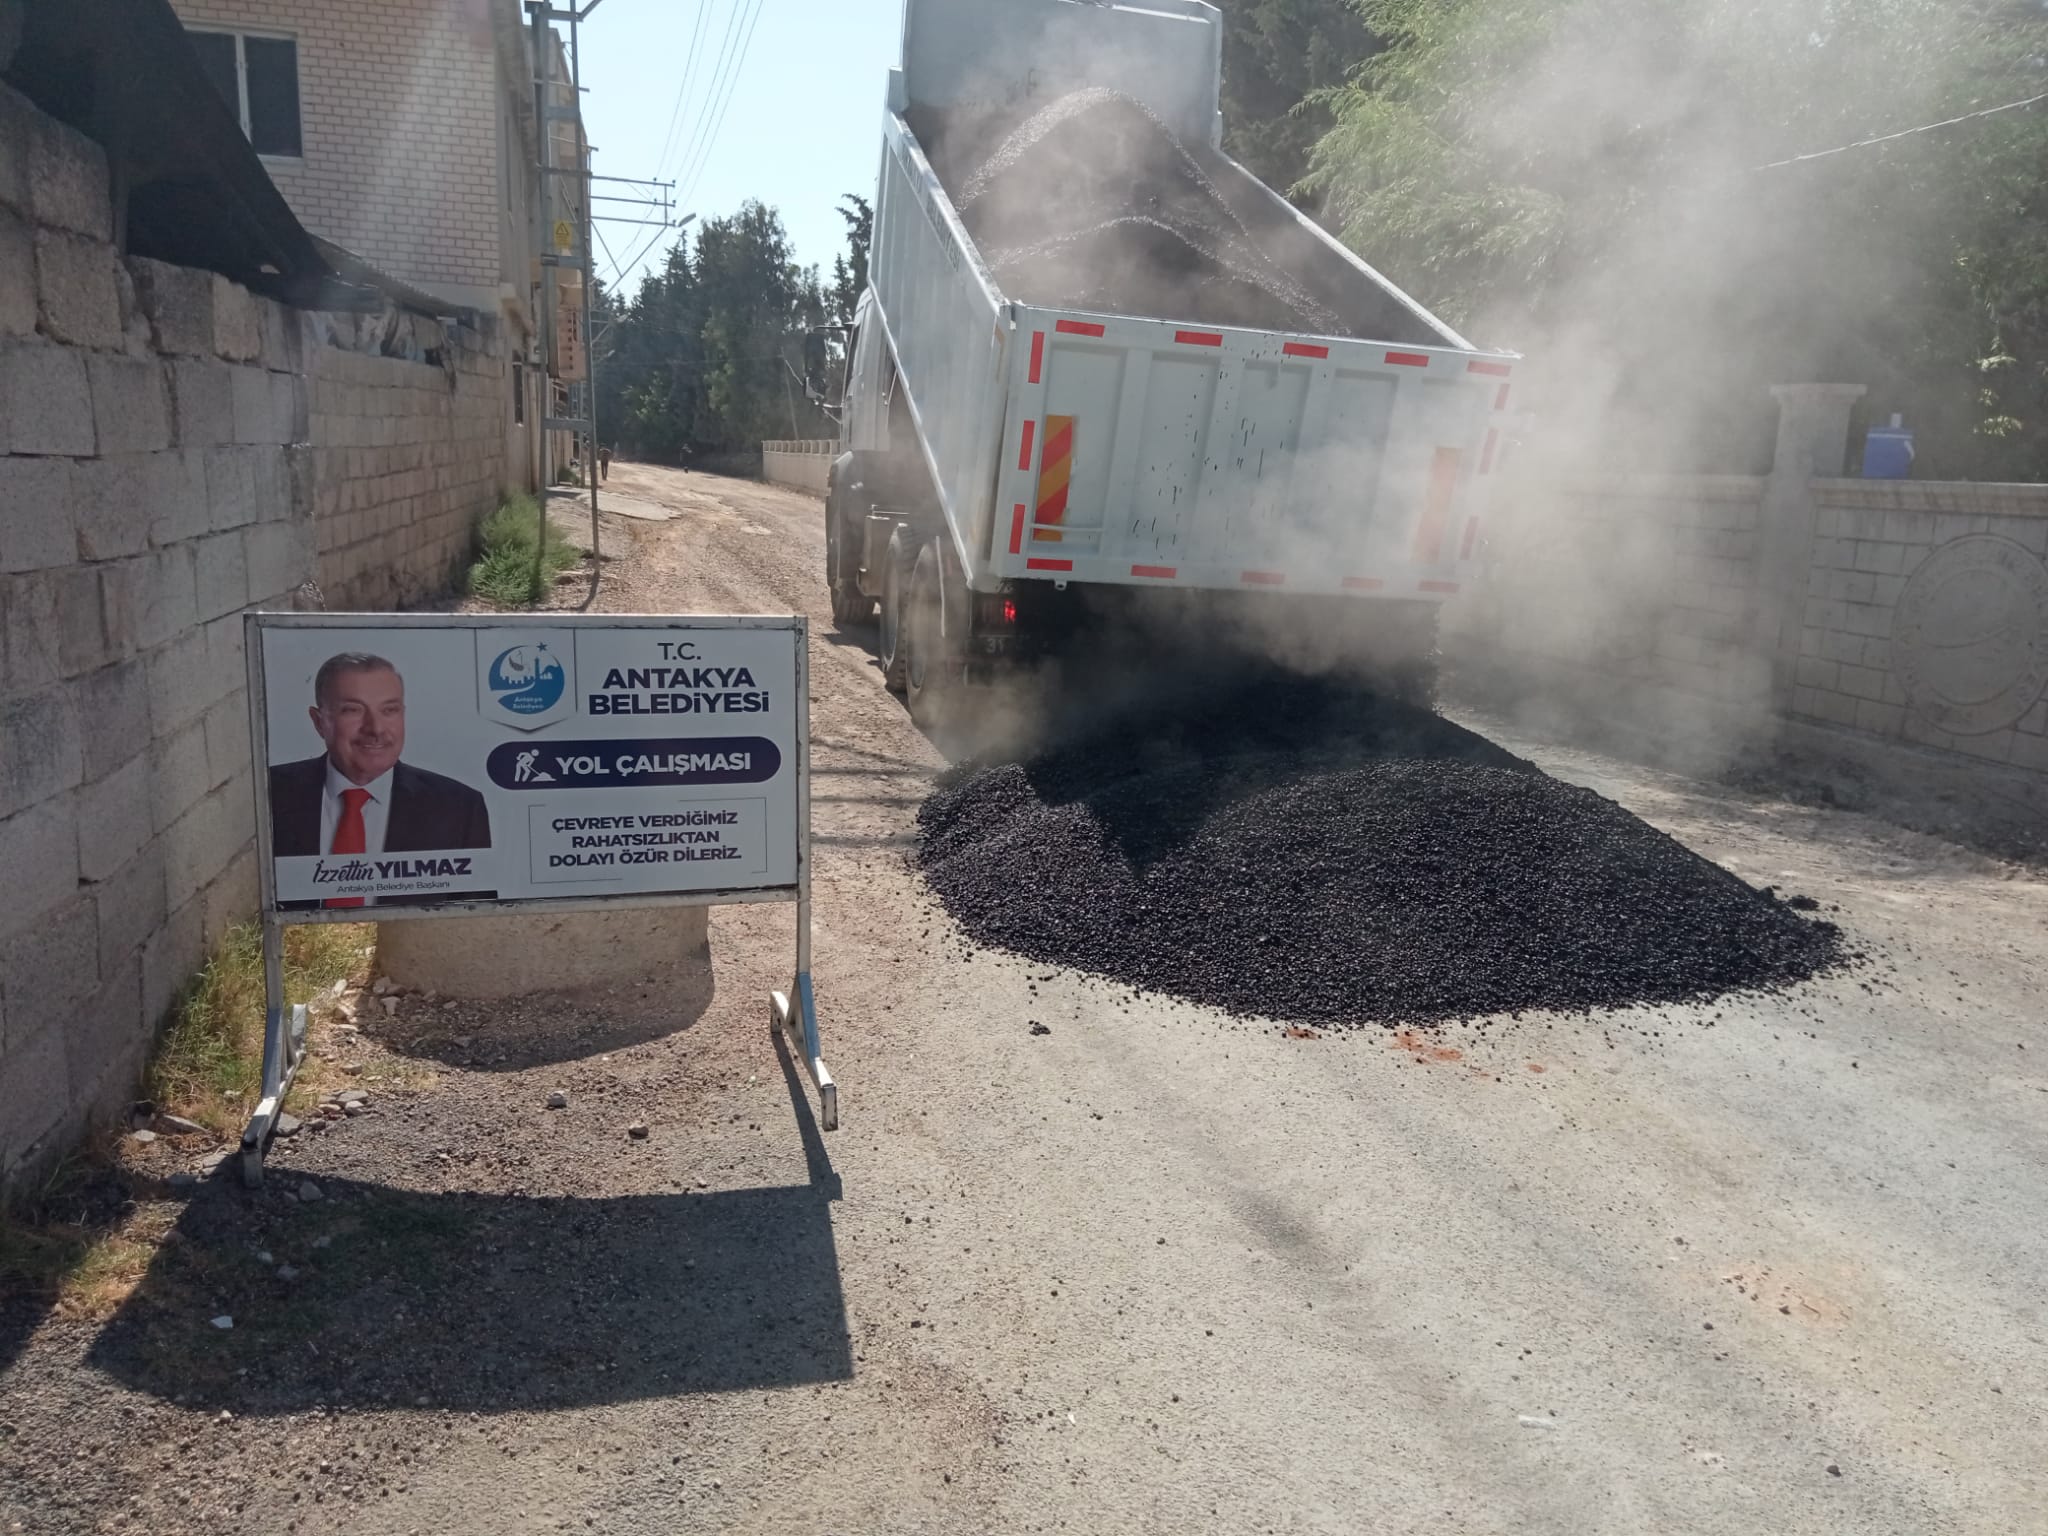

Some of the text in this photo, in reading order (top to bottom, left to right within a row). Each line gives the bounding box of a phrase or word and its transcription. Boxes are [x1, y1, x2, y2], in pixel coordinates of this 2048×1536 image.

[657, 642, 701, 660] T.C.
[602, 667, 756, 689] ANTAKYA
[589, 691, 769, 715] BELEDİYESİ
[555, 752, 751, 777] YOL ÇALIŞMASI
[552, 810, 738, 833] ÇEVREYE VERDİĞİMİZ
[572, 830, 720, 848] RAHATSIZLIKTAN
[549, 845, 742, 867] DOLAYI ÖZÜR DİLERİZ.
[312, 857, 472, 883] İzzettin YILMAZ
[336, 881, 450, 893] Antakya Belediye Başkanı
